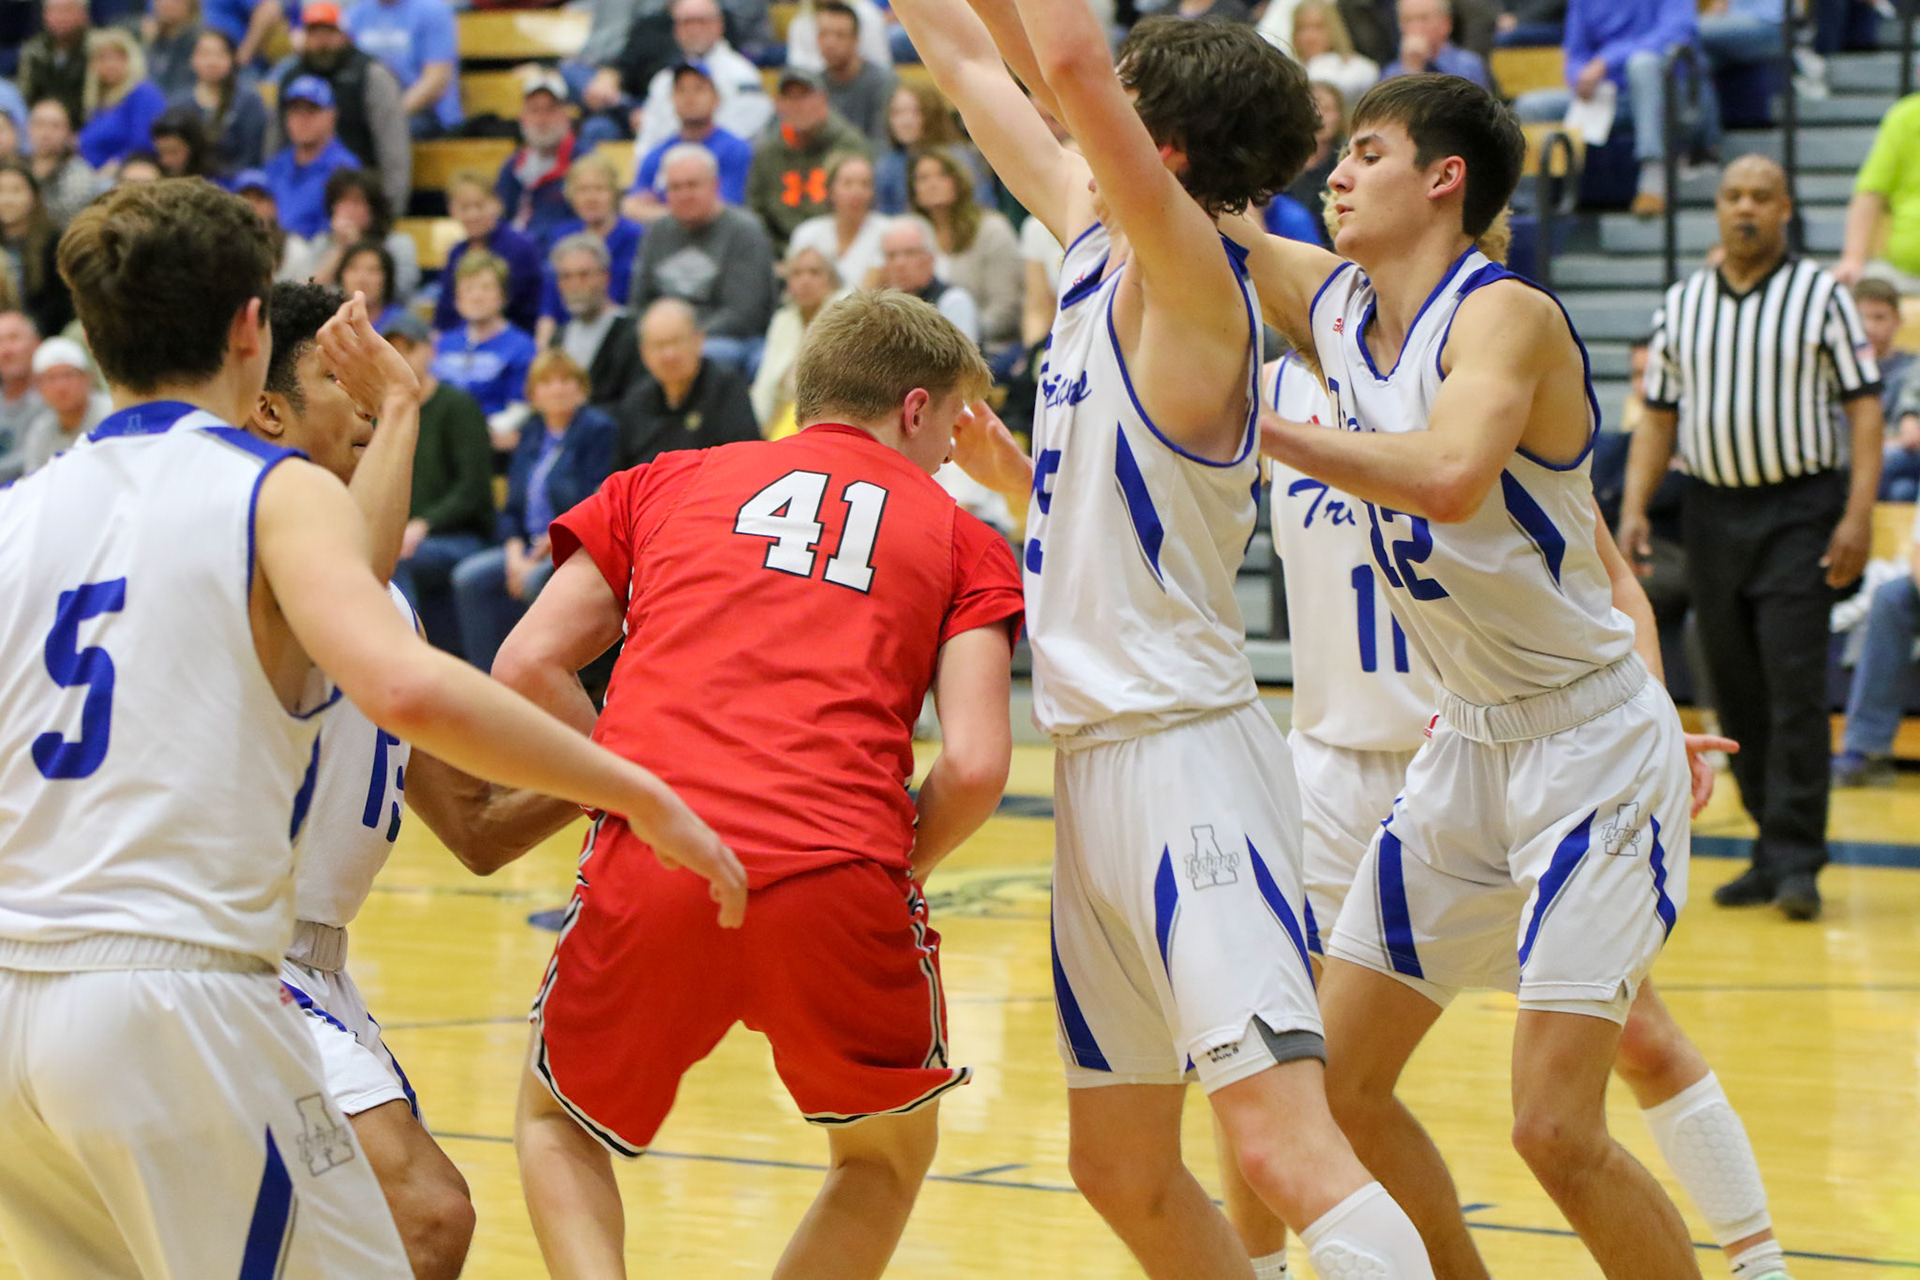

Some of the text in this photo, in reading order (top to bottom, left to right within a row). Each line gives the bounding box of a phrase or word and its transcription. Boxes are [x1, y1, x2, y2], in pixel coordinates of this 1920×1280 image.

[732, 469, 890, 596] 41
[1360, 499, 1450, 601] 12
[31, 576, 127, 779] 5
